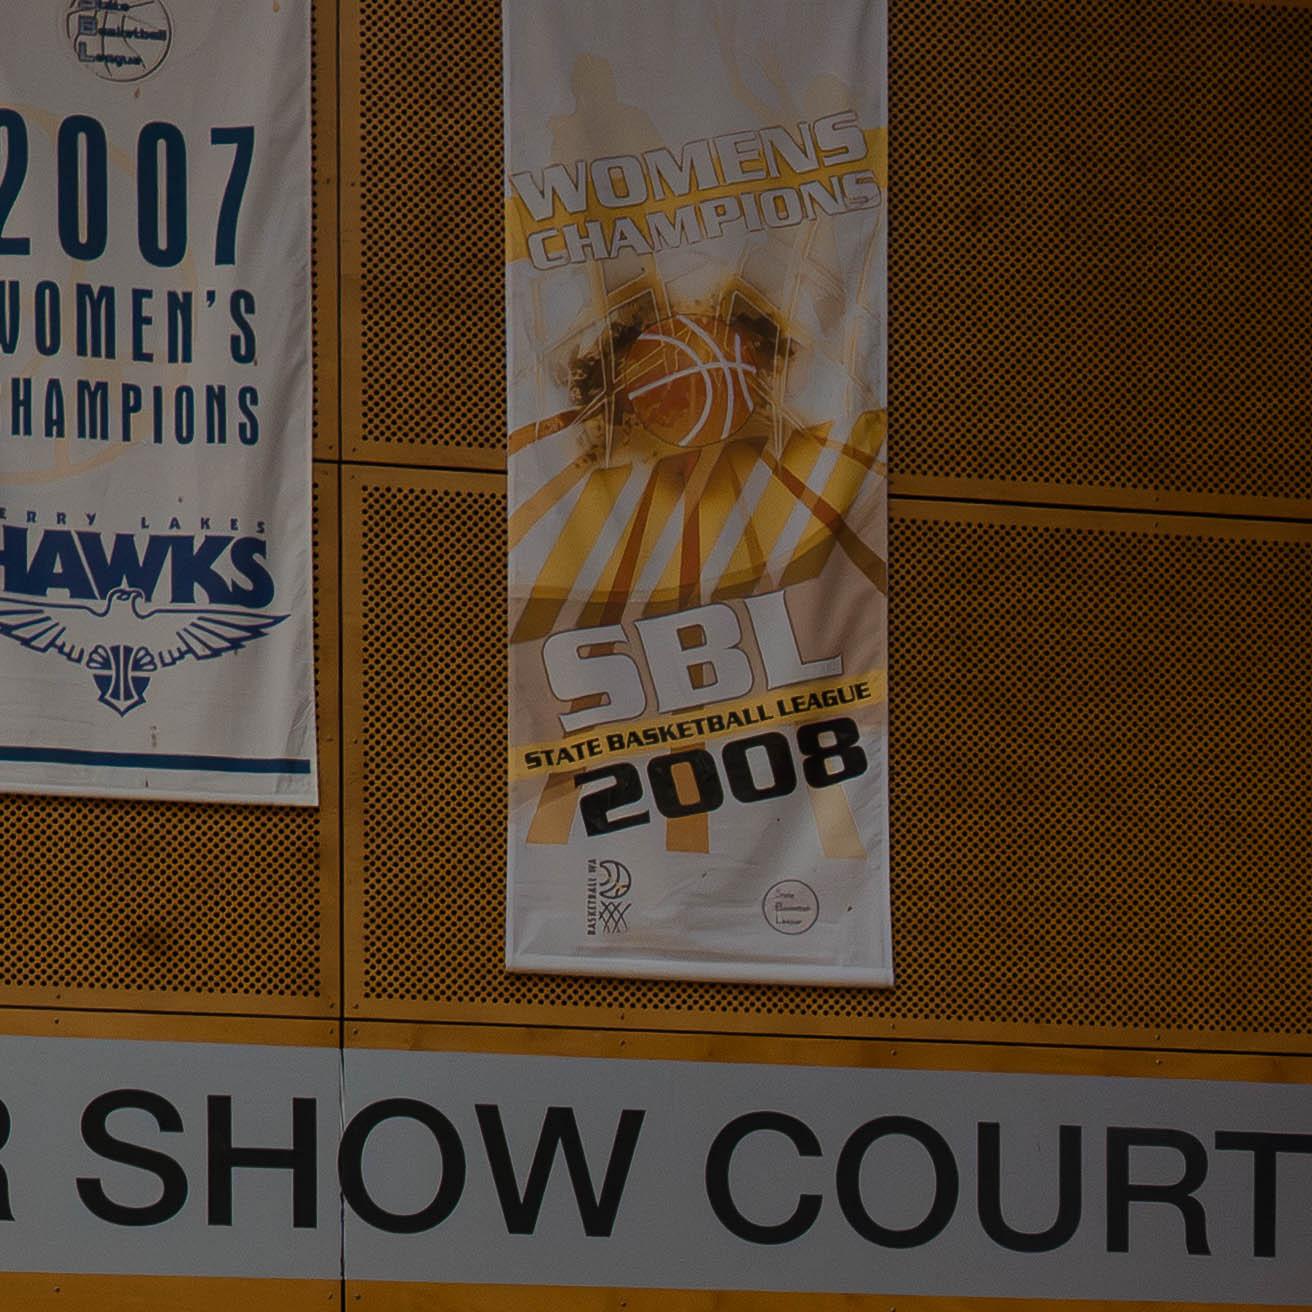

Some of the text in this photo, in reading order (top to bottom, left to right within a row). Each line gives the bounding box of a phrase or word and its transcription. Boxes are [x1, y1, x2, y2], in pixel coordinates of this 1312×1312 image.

[0, 109, 255, 267] 2007
[511, 110, 868, 223] WOMENS
[527, 169, 881, 271] CHAMPIONS
[11, 377, 259, 446] HAMPIONS
[141, 516, 265, 534] LAKES
[542, 589, 845, 737] SBL
[525, 681, 872, 769] STATE BASKETBALL LEAGUE
[574, 717, 868, 836] 2008
[76, 1089, 646, 1237] SHOW
